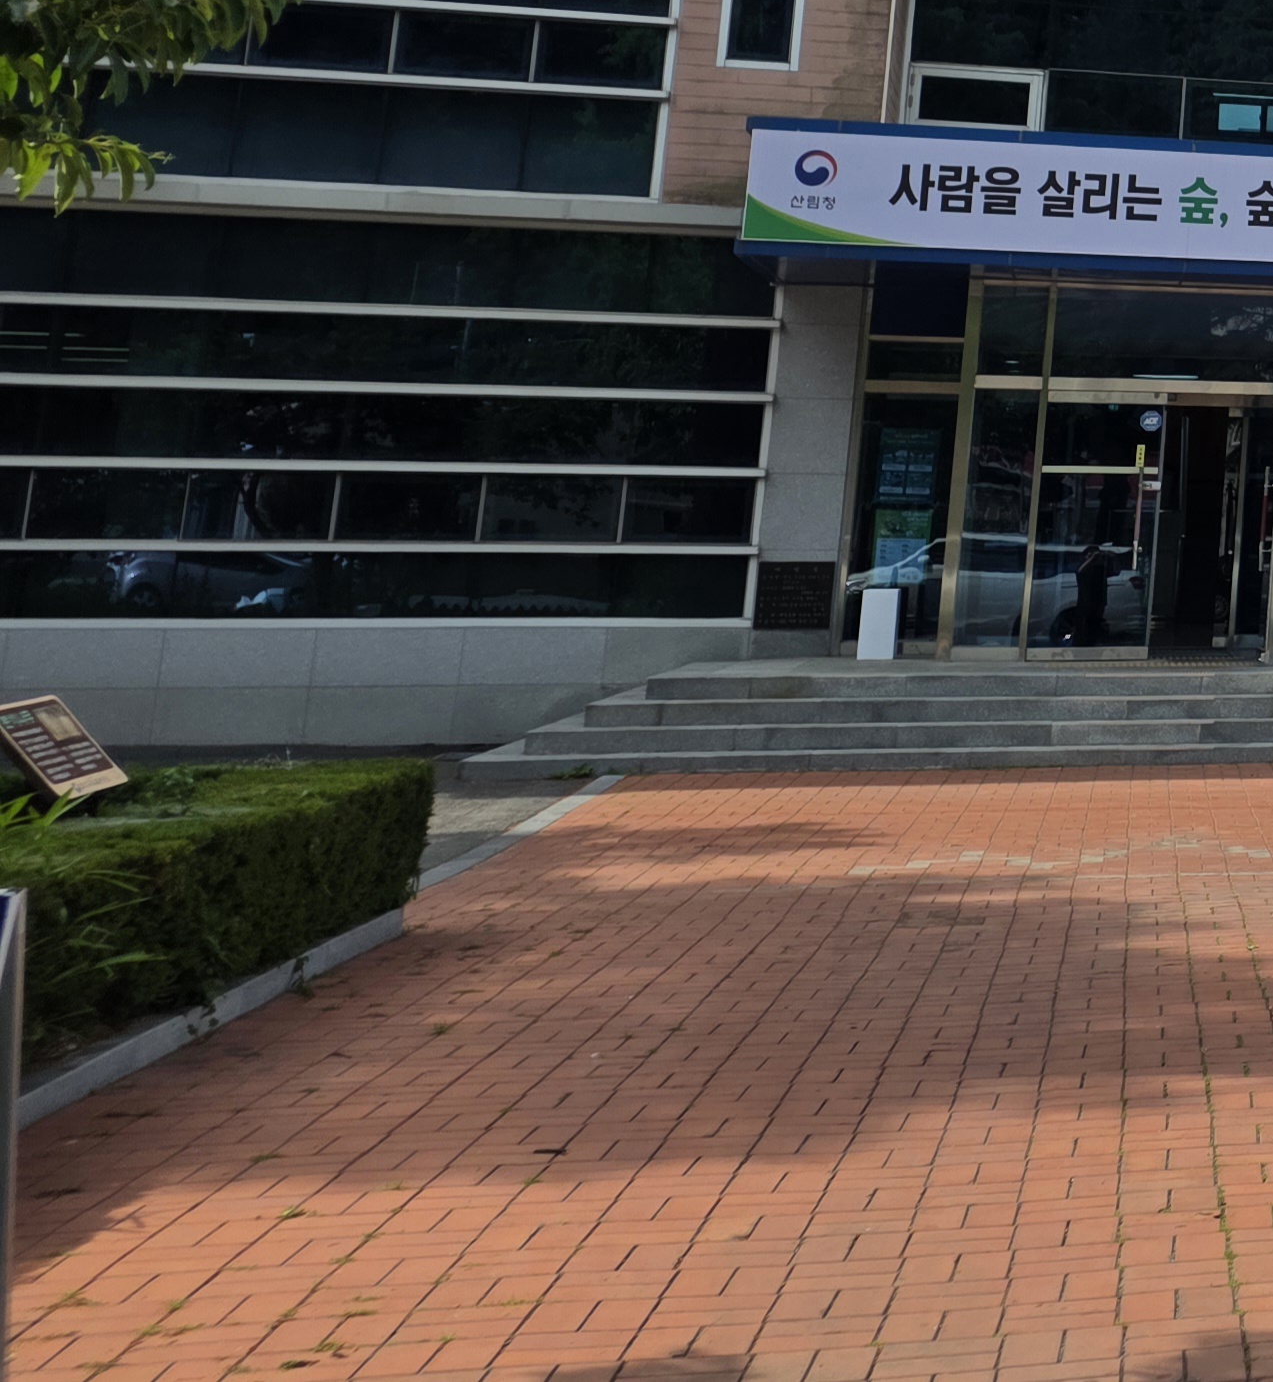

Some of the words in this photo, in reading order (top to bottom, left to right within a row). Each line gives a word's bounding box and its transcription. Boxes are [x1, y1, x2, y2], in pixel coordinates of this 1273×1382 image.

[790, 195, 836, 210] 산림청
[889, 162, 1022, 216] 사람을
[1037, 170, 1163, 223] 살리는
[1179, 177, 1230, 229] 숲,
